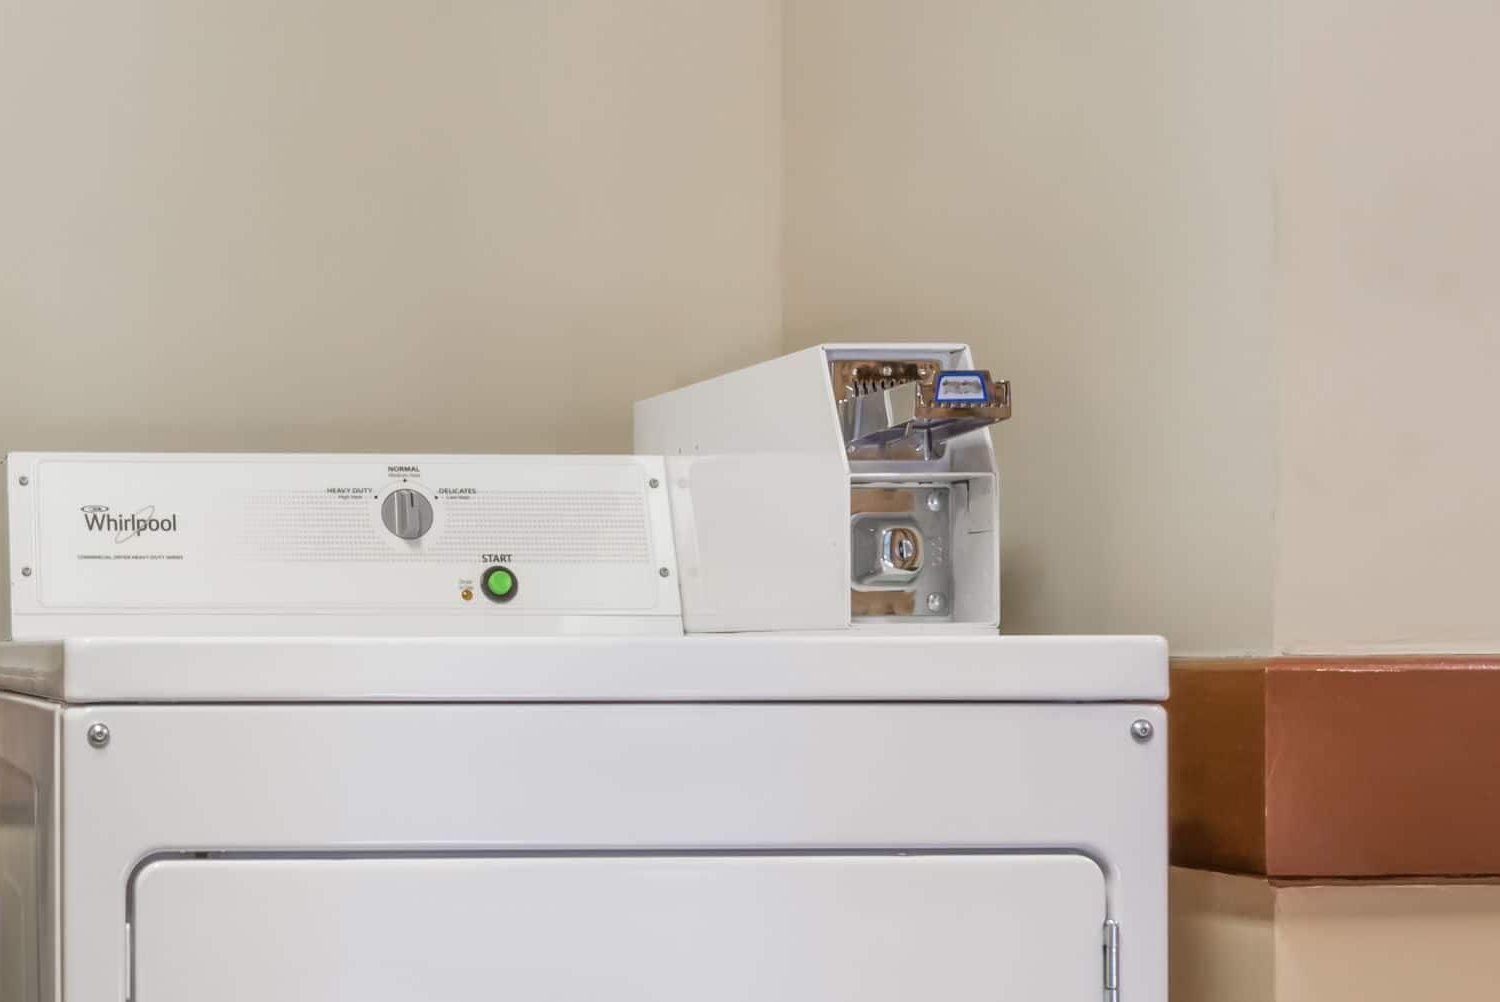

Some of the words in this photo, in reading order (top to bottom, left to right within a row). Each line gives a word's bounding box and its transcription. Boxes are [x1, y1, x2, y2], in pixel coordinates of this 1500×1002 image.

[388, 465, 421, 473] NORMAL
[326, 487, 351, 495] HEAVY
[351, 487, 373, 495] DUTY
[438, 487, 477, 495] DELICATES
[84, 513, 177, 537] Whirlpool
[482, 553, 513, 563] START
